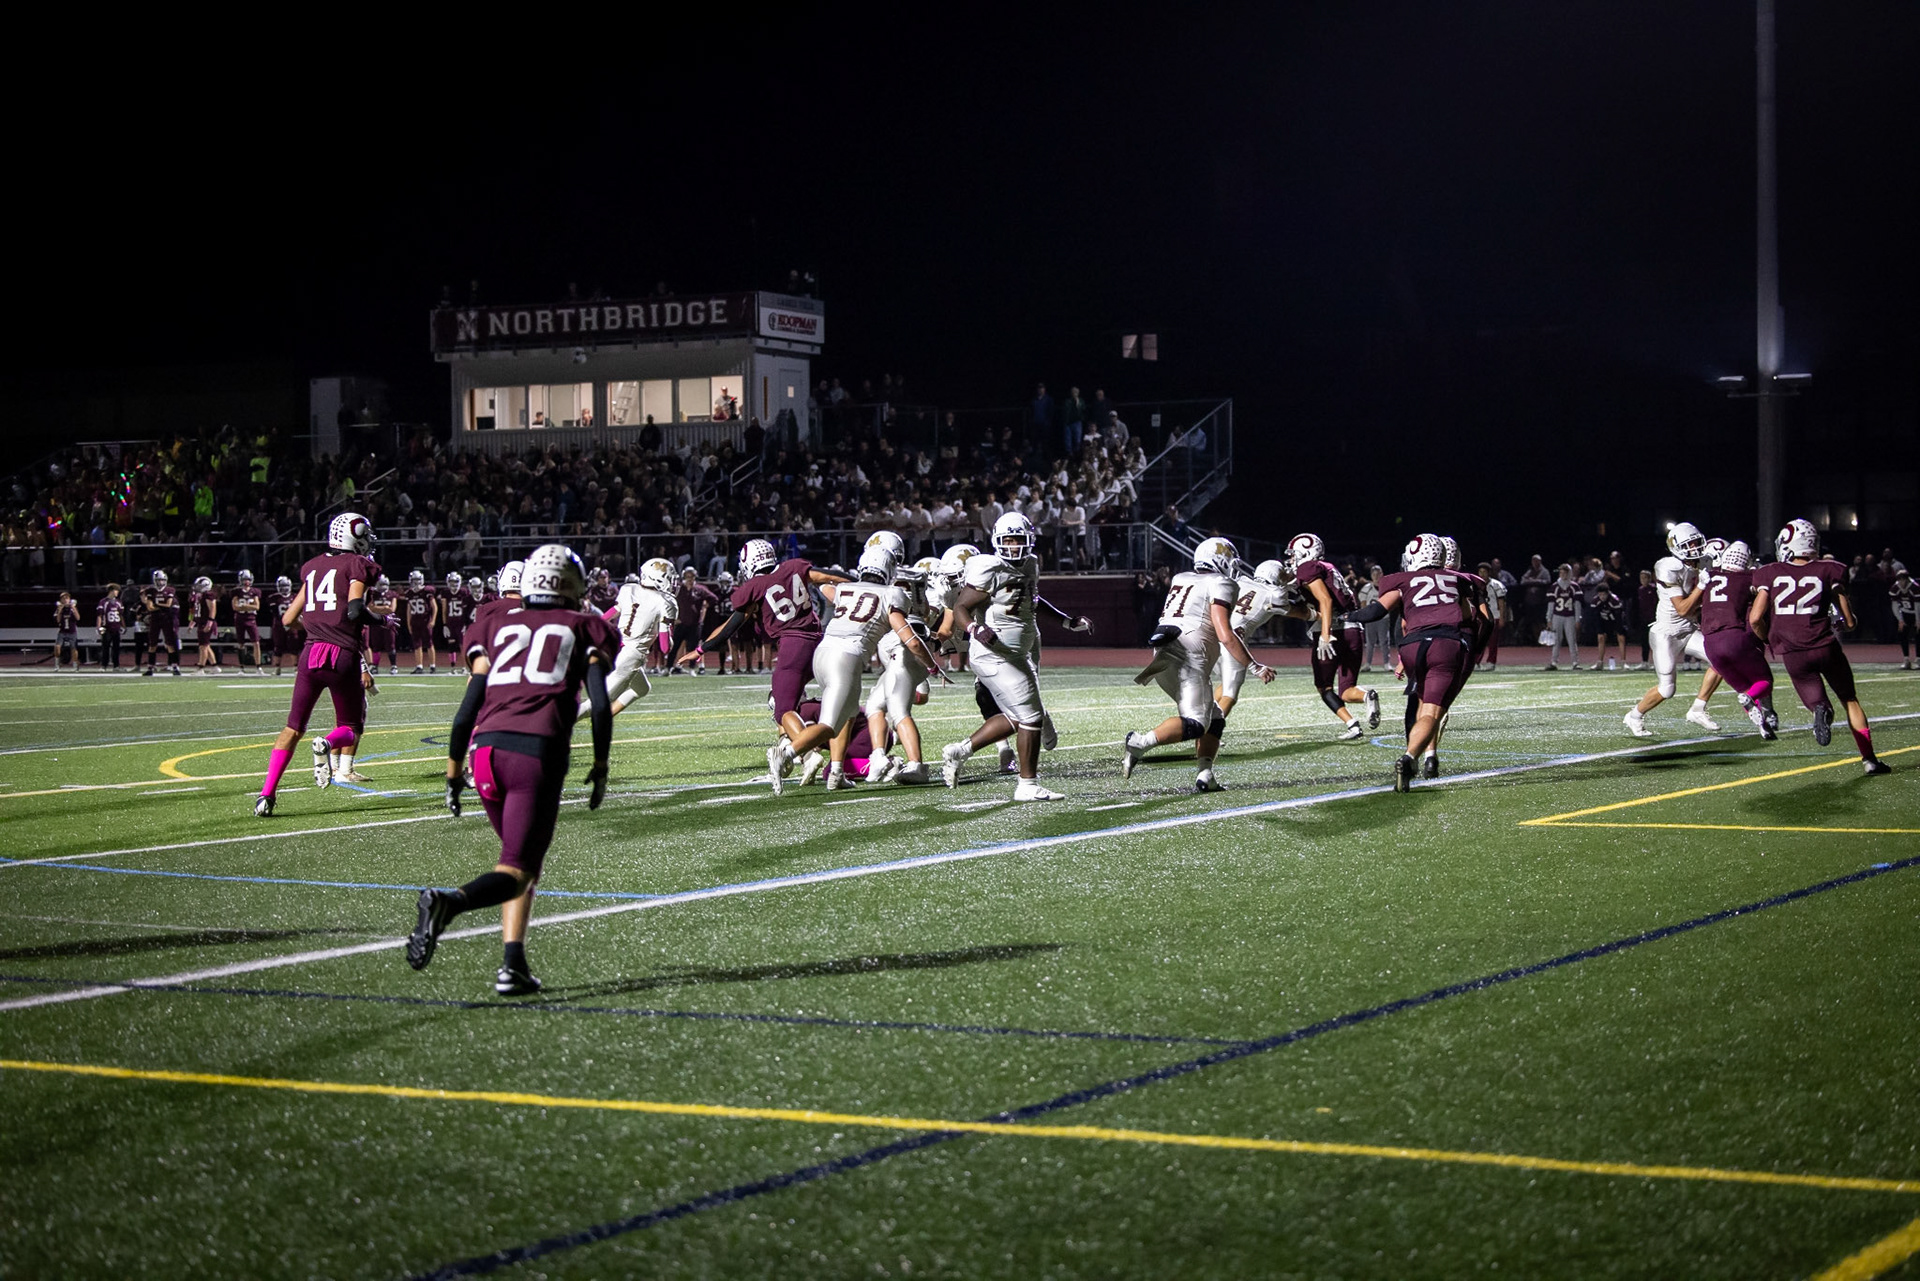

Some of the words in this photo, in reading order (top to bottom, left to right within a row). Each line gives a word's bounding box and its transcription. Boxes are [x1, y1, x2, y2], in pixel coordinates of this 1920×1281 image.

[488, 299, 728, 336] NORTHBRIDGE
[305, 567, 337, 612] 14
[765, 573, 811, 622] 64
[1409, 573, 1459, 607] 25
[1555, 598, 1573, 612] 34
[1710, 575, 1728, 602] 2
[1773, 575, 1823, 615] 22
[107, 610, 120, 623] 65
[410, 599, 425, 615] 56
[448, 600, 463, 617] 15
[623, 603, 640, 637] 1
[834, 590, 880, 623] 50
[487, 623, 576, 687] 20
